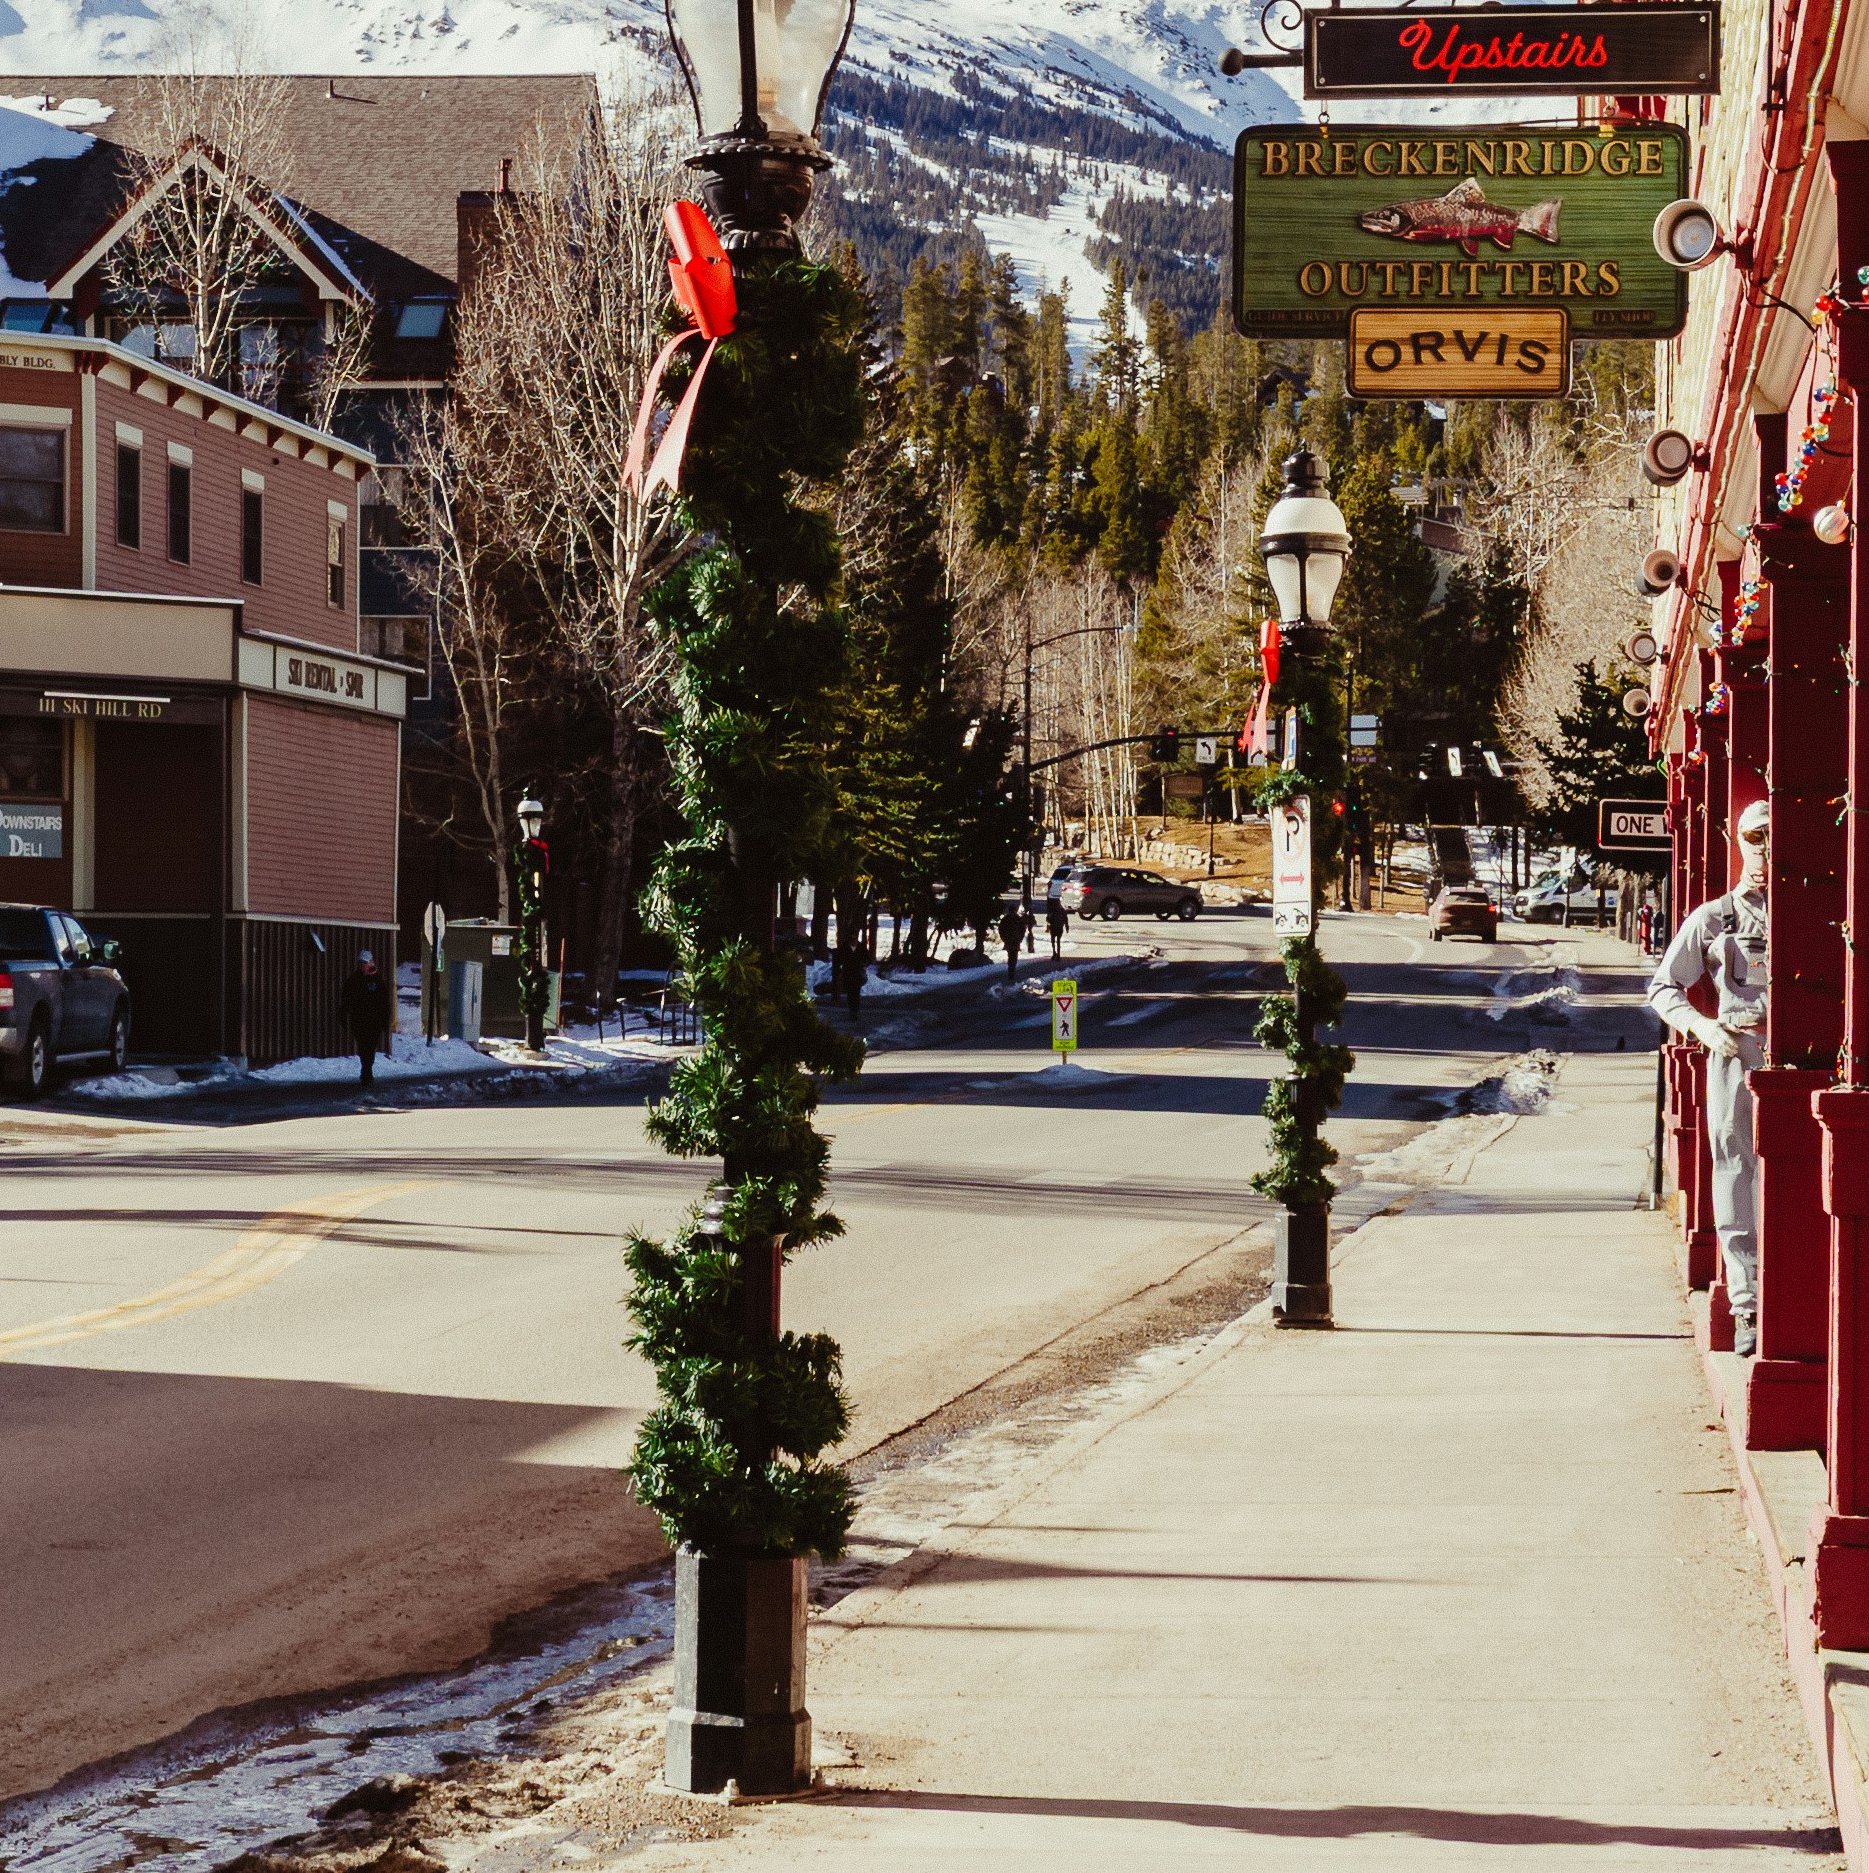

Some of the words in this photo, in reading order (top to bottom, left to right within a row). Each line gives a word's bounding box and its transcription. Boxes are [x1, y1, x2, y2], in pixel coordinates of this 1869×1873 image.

[1398, 18, 1608, 84] Upstairs
[1261, 138, 1664, 177] BRECKENRIDGE
[1298, 259, 1621, 298] OUTFITTERS
[0, 354, 18, 366] BLY
[23, 356, 56, 369] BLDG.
[1364, 329, 1551, 374] ORVIS
[288, 657, 303, 686] SKI
[304, 661, 338, 693] RENTAL
[63, 699, 88, 714] SKI
[95, 701, 132, 717] HILL
[138, 703, 162, 718] RD
[1616, 815, 1654, 834] ONE
[9, 834, 42, 857] DELI
